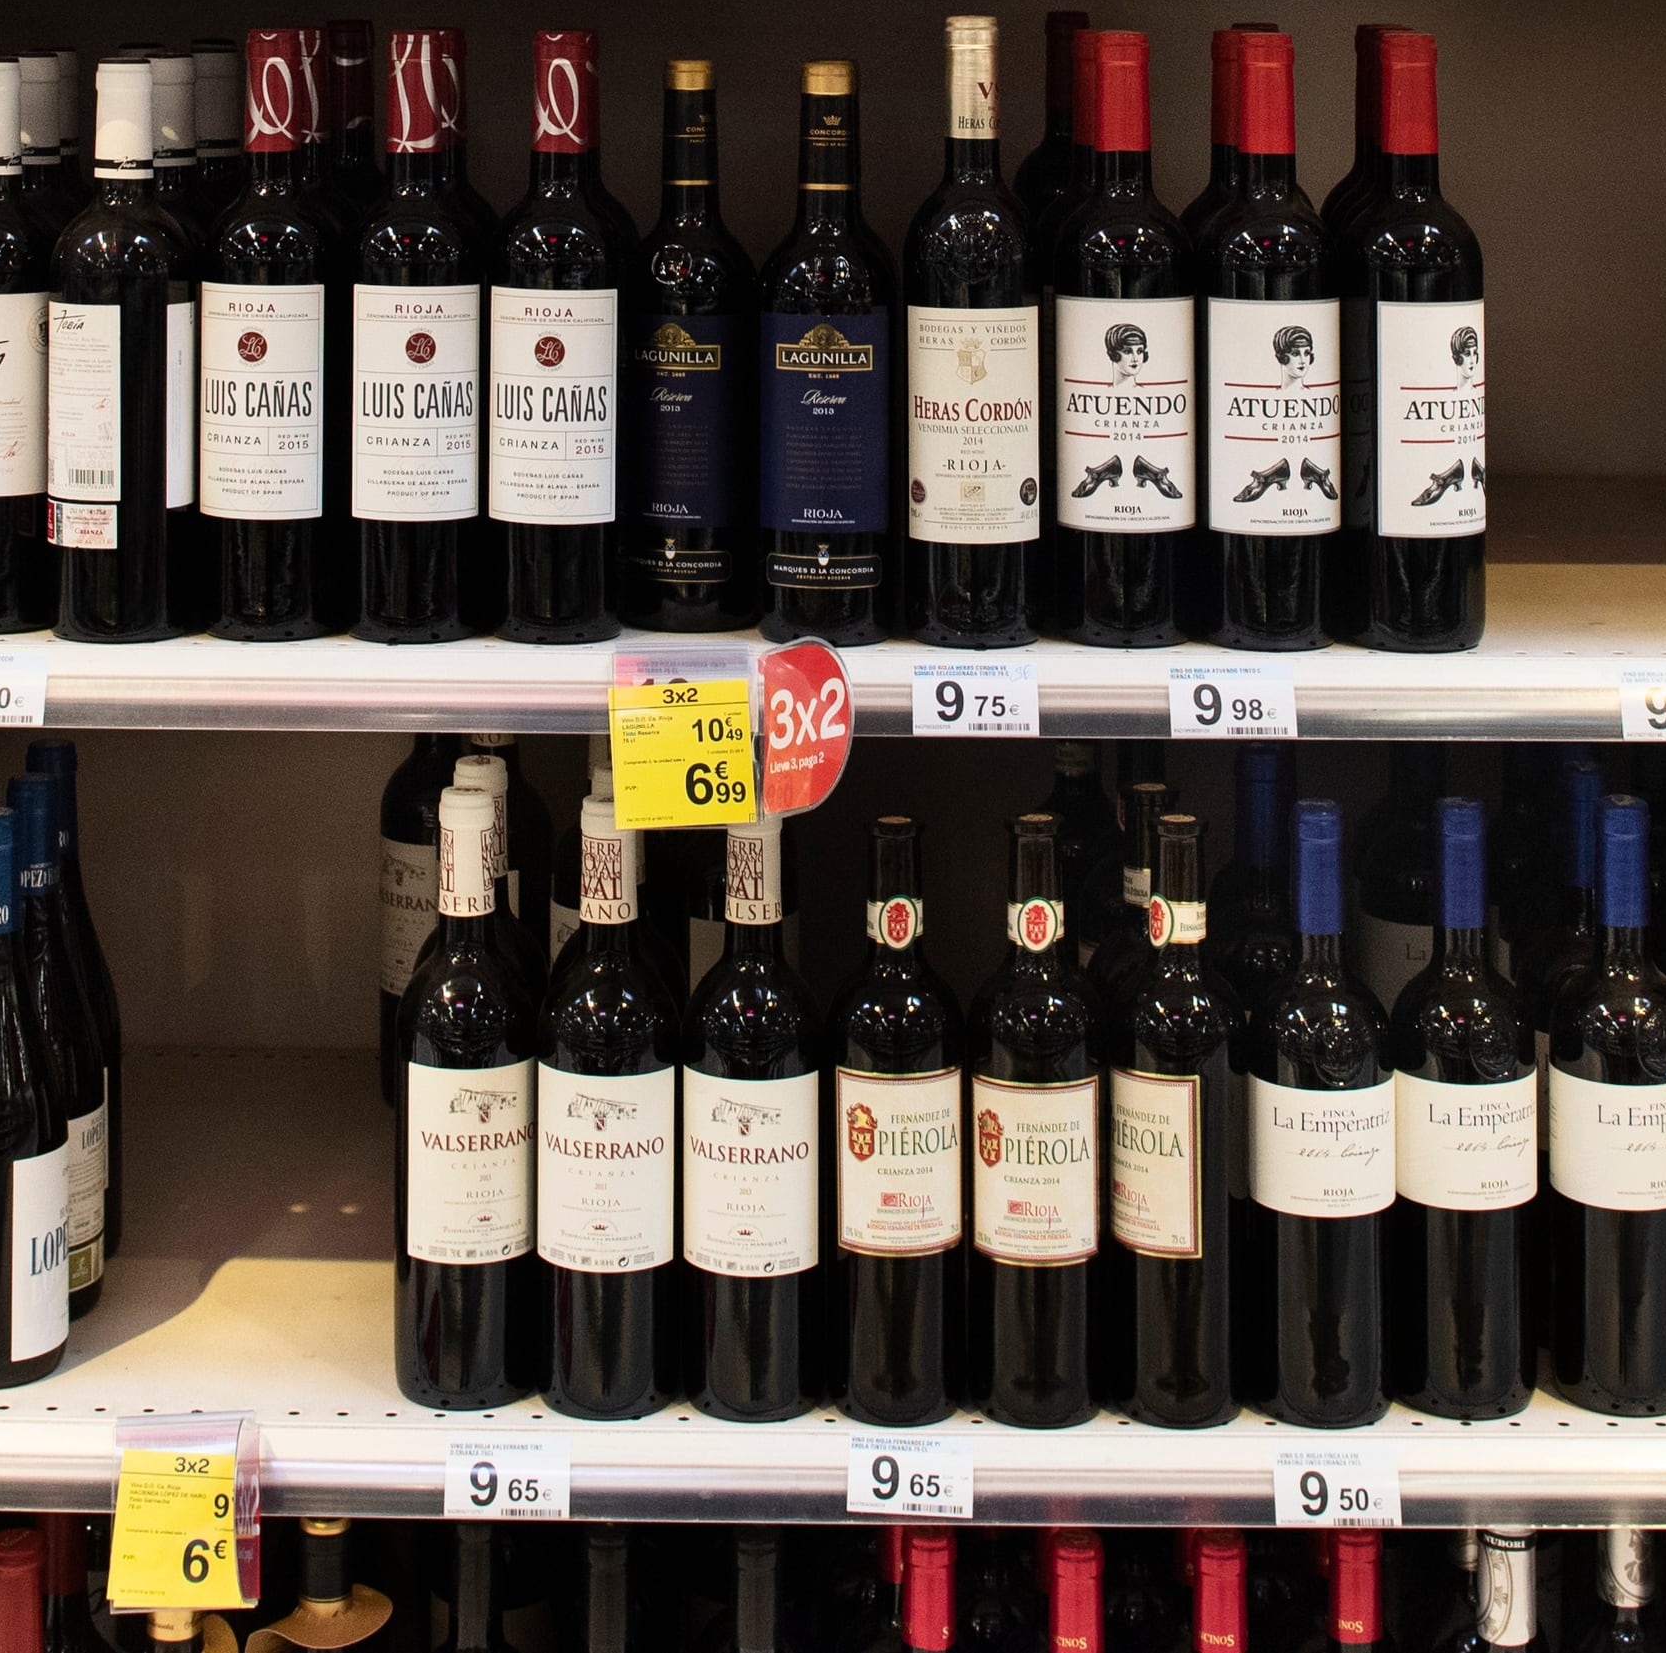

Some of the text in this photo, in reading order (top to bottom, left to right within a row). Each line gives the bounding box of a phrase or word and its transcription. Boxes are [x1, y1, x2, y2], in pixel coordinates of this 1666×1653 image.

[394, 303, 444, 315] RIOJA
[781, 350, 868, 366] LAGUNILLA
[362, 380, 474, 419] LUIS CAÑAS
[913, 396, 1033, 422] HERAS CORDÓN
[1066, 392, 1188, 416] ATUENDO
[918, 423, 1029, 435] VENDIMIA SELECCIONADA
[1094, 418, 1160, 430] CRIANZA
[773, 565, 808, 574] MARQUES
[829, 566, 874, 575] CONCORDIA
[662, 687, 699, 704] 3x2
[935, 680, 1006, 722] 9 75
[1193, 684, 1264, 726] 9 98
[769, 677, 846, 751] 3x2
[692, 718, 743, 743] 10 49
[685, 762, 714, 805] 6
[716, 781, 747, 804] 99
[1015, 1119, 1080, 1134] FERNÁNDEZ DE
[1272, 1106, 1392, 1141] La Emperatriz
[1322, 1108, 1356, 1119] FINCA
[544, 1131, 666, 1161] VALSERRANO
[1004, 1133, 1091, 1166] PIÉROLA
[174, 1457, 210, 1474] 3x2
[871, 1454, 940, 1500] 9 65
[469, 1461, 539, 1507] 9 65
[1299, 1470, 1369, 1517] 9 50
[213, 1493, 230, 1519] 9
[1483, 1536, 1527, 1549] NUBORI
[182, 1539, 211, 1584] 6
